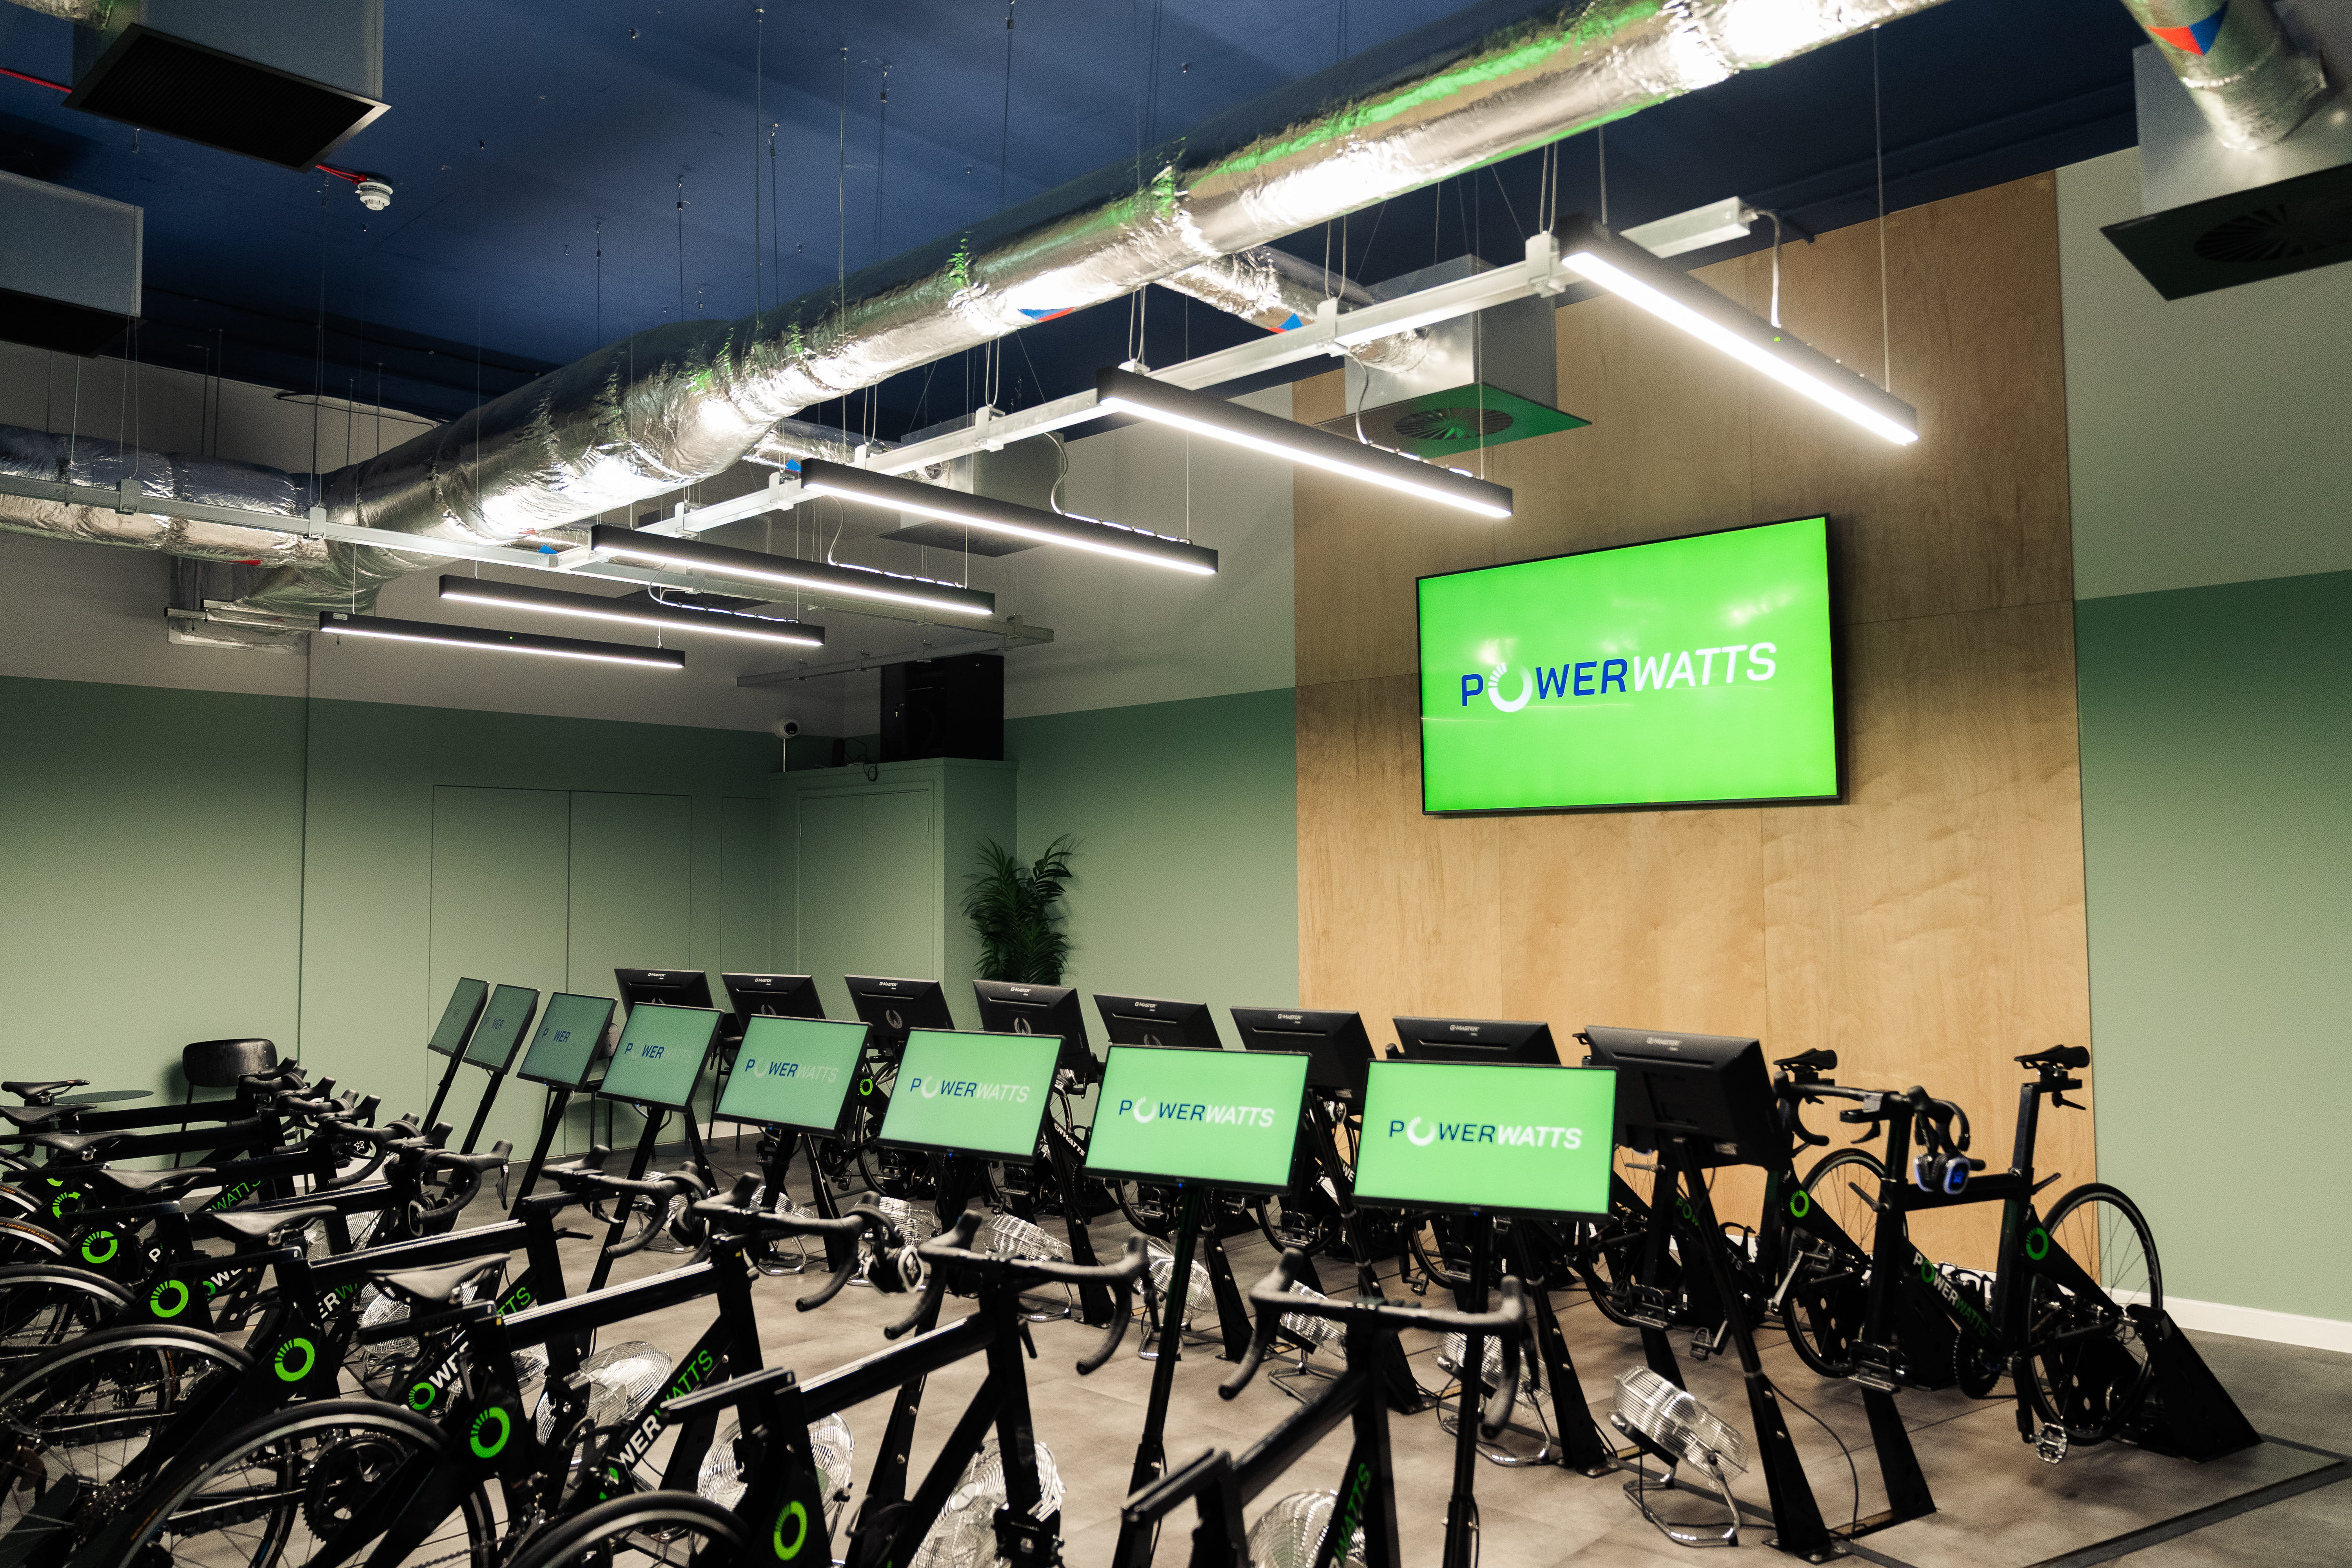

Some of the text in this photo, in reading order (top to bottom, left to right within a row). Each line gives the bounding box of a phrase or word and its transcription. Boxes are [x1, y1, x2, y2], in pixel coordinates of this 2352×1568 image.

[1462, 642, 1777, 713] POWERWATTS
[541, 1028, 571, 1043] PWER
[744, 1057, 839, 1082] POWERWATTS
[910, 1076, 1030, 1103] POWERWATTS
[1119, 1096, 1275, 1127] POWERWATTS
[1388, 1116, 1583, 1150] POWERWATTS
[6, 1223, 55, 1243] HOMETRAINER
[1913, 1251, 1989, 1336] POWERWATTS
